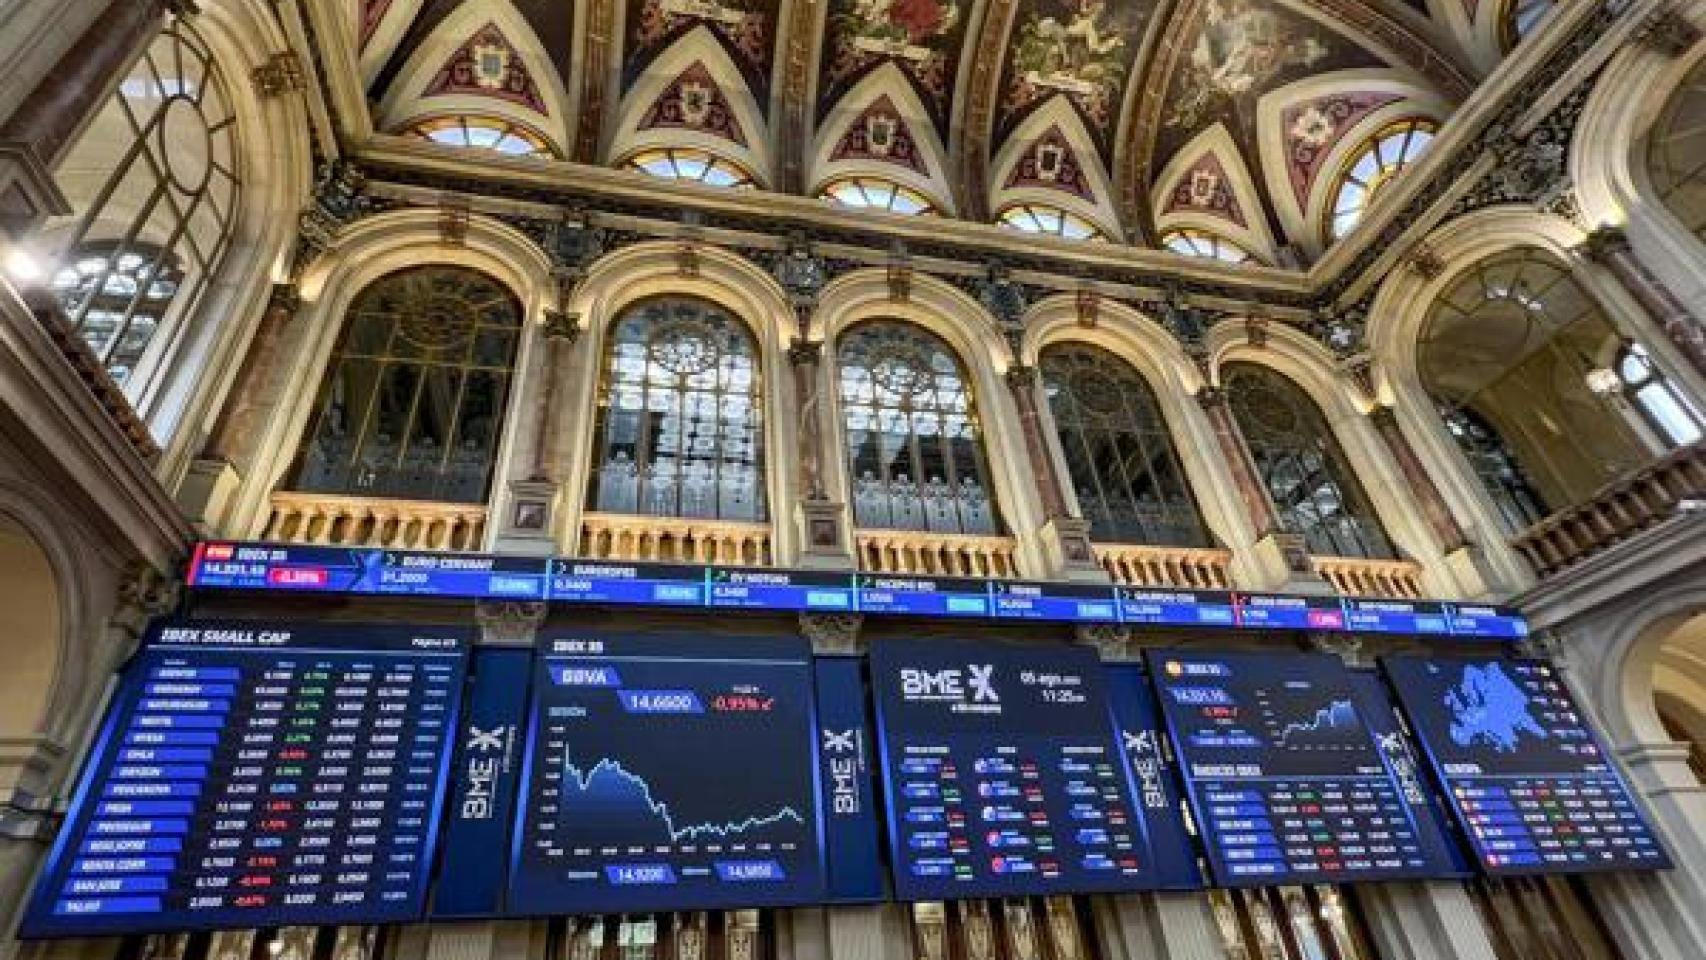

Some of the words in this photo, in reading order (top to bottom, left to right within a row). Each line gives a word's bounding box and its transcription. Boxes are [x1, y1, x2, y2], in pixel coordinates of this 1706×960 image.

[161, 627, 200, 643] IBEX
[202, 630, 254, 643] SMALL
[258, 632, 291, 644] CAP
[553, 640, 584, 653] IBEX
[562, 669, 607, 684] BBVA
[901, 669, 964, 695] BME
[462, 757, 491, 819] BME
[832, 758, 854, 813] BME
[1133, 756, 1162, 808] BME
